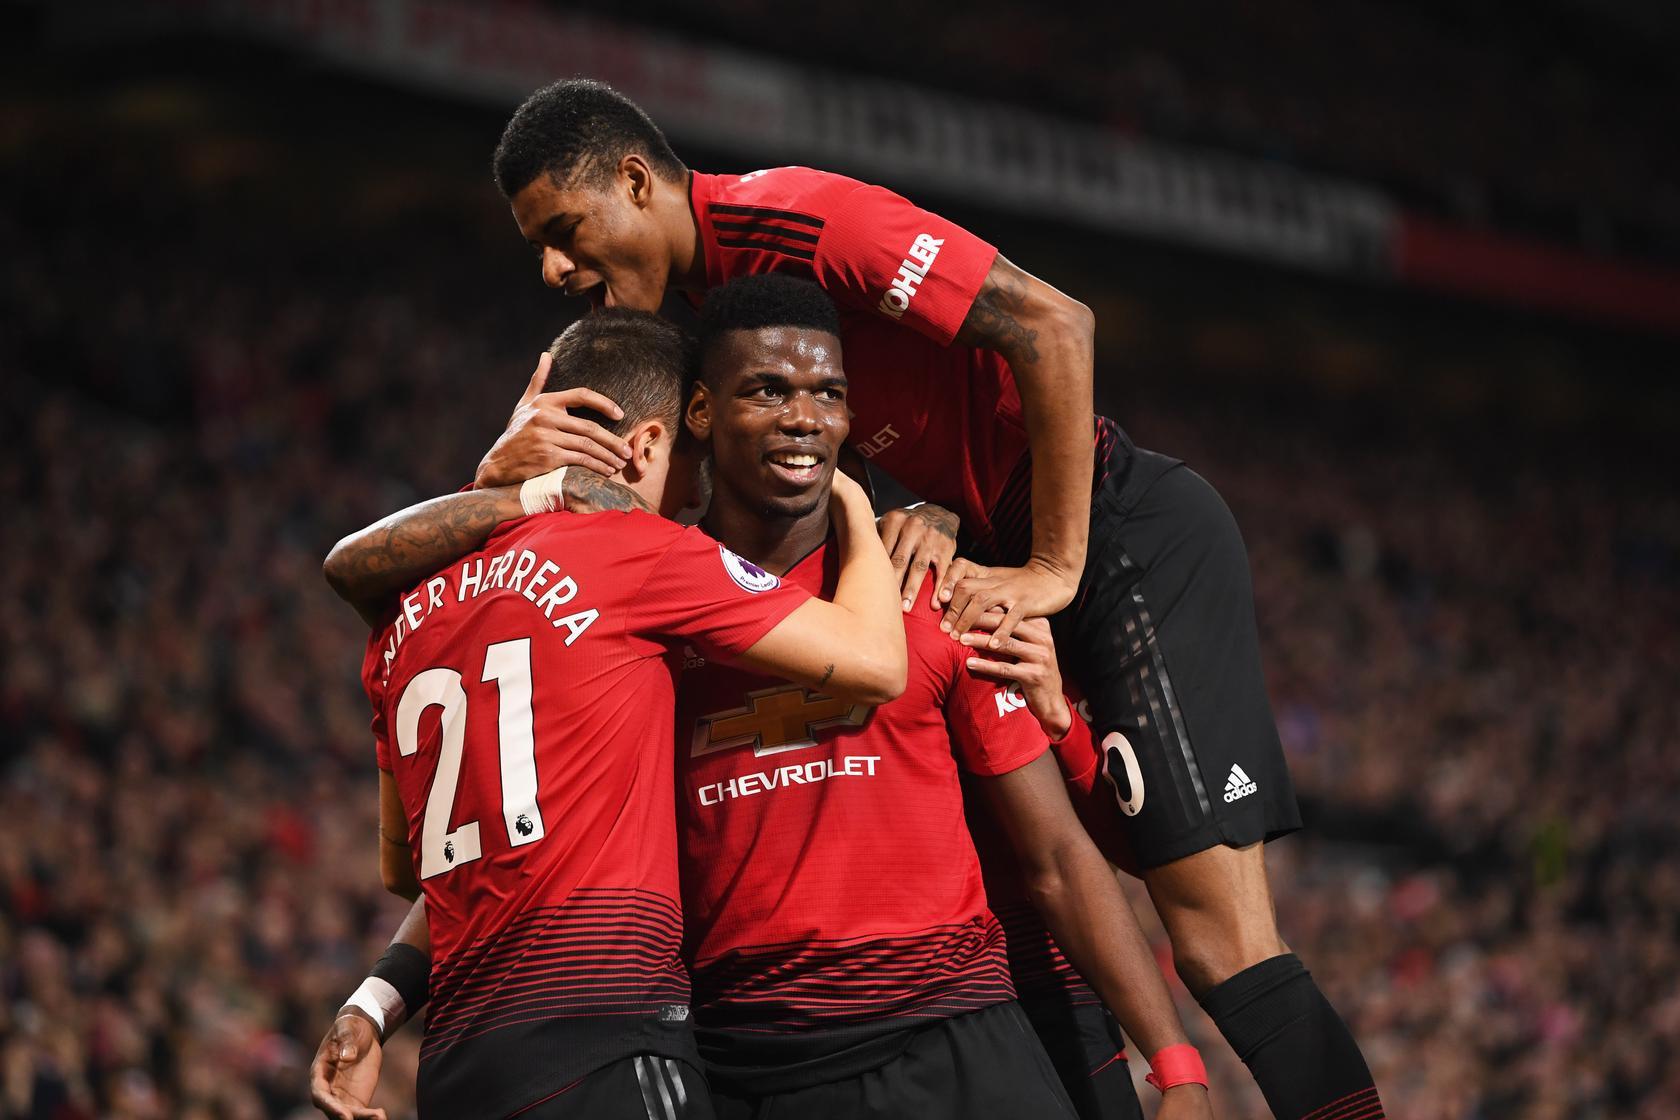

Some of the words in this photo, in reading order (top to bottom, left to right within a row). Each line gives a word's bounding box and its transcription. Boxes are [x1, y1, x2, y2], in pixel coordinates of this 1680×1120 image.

[878, 232, 945, 321] KOHLER
[382, 576, 447, 688] NDER
[457, 549, 600, 647] HERRERA
[396, 636, 546, 881] 21
[698, 755, 881, 806] CHEVROLET
[1223, 780, 1259, 804] adidas
